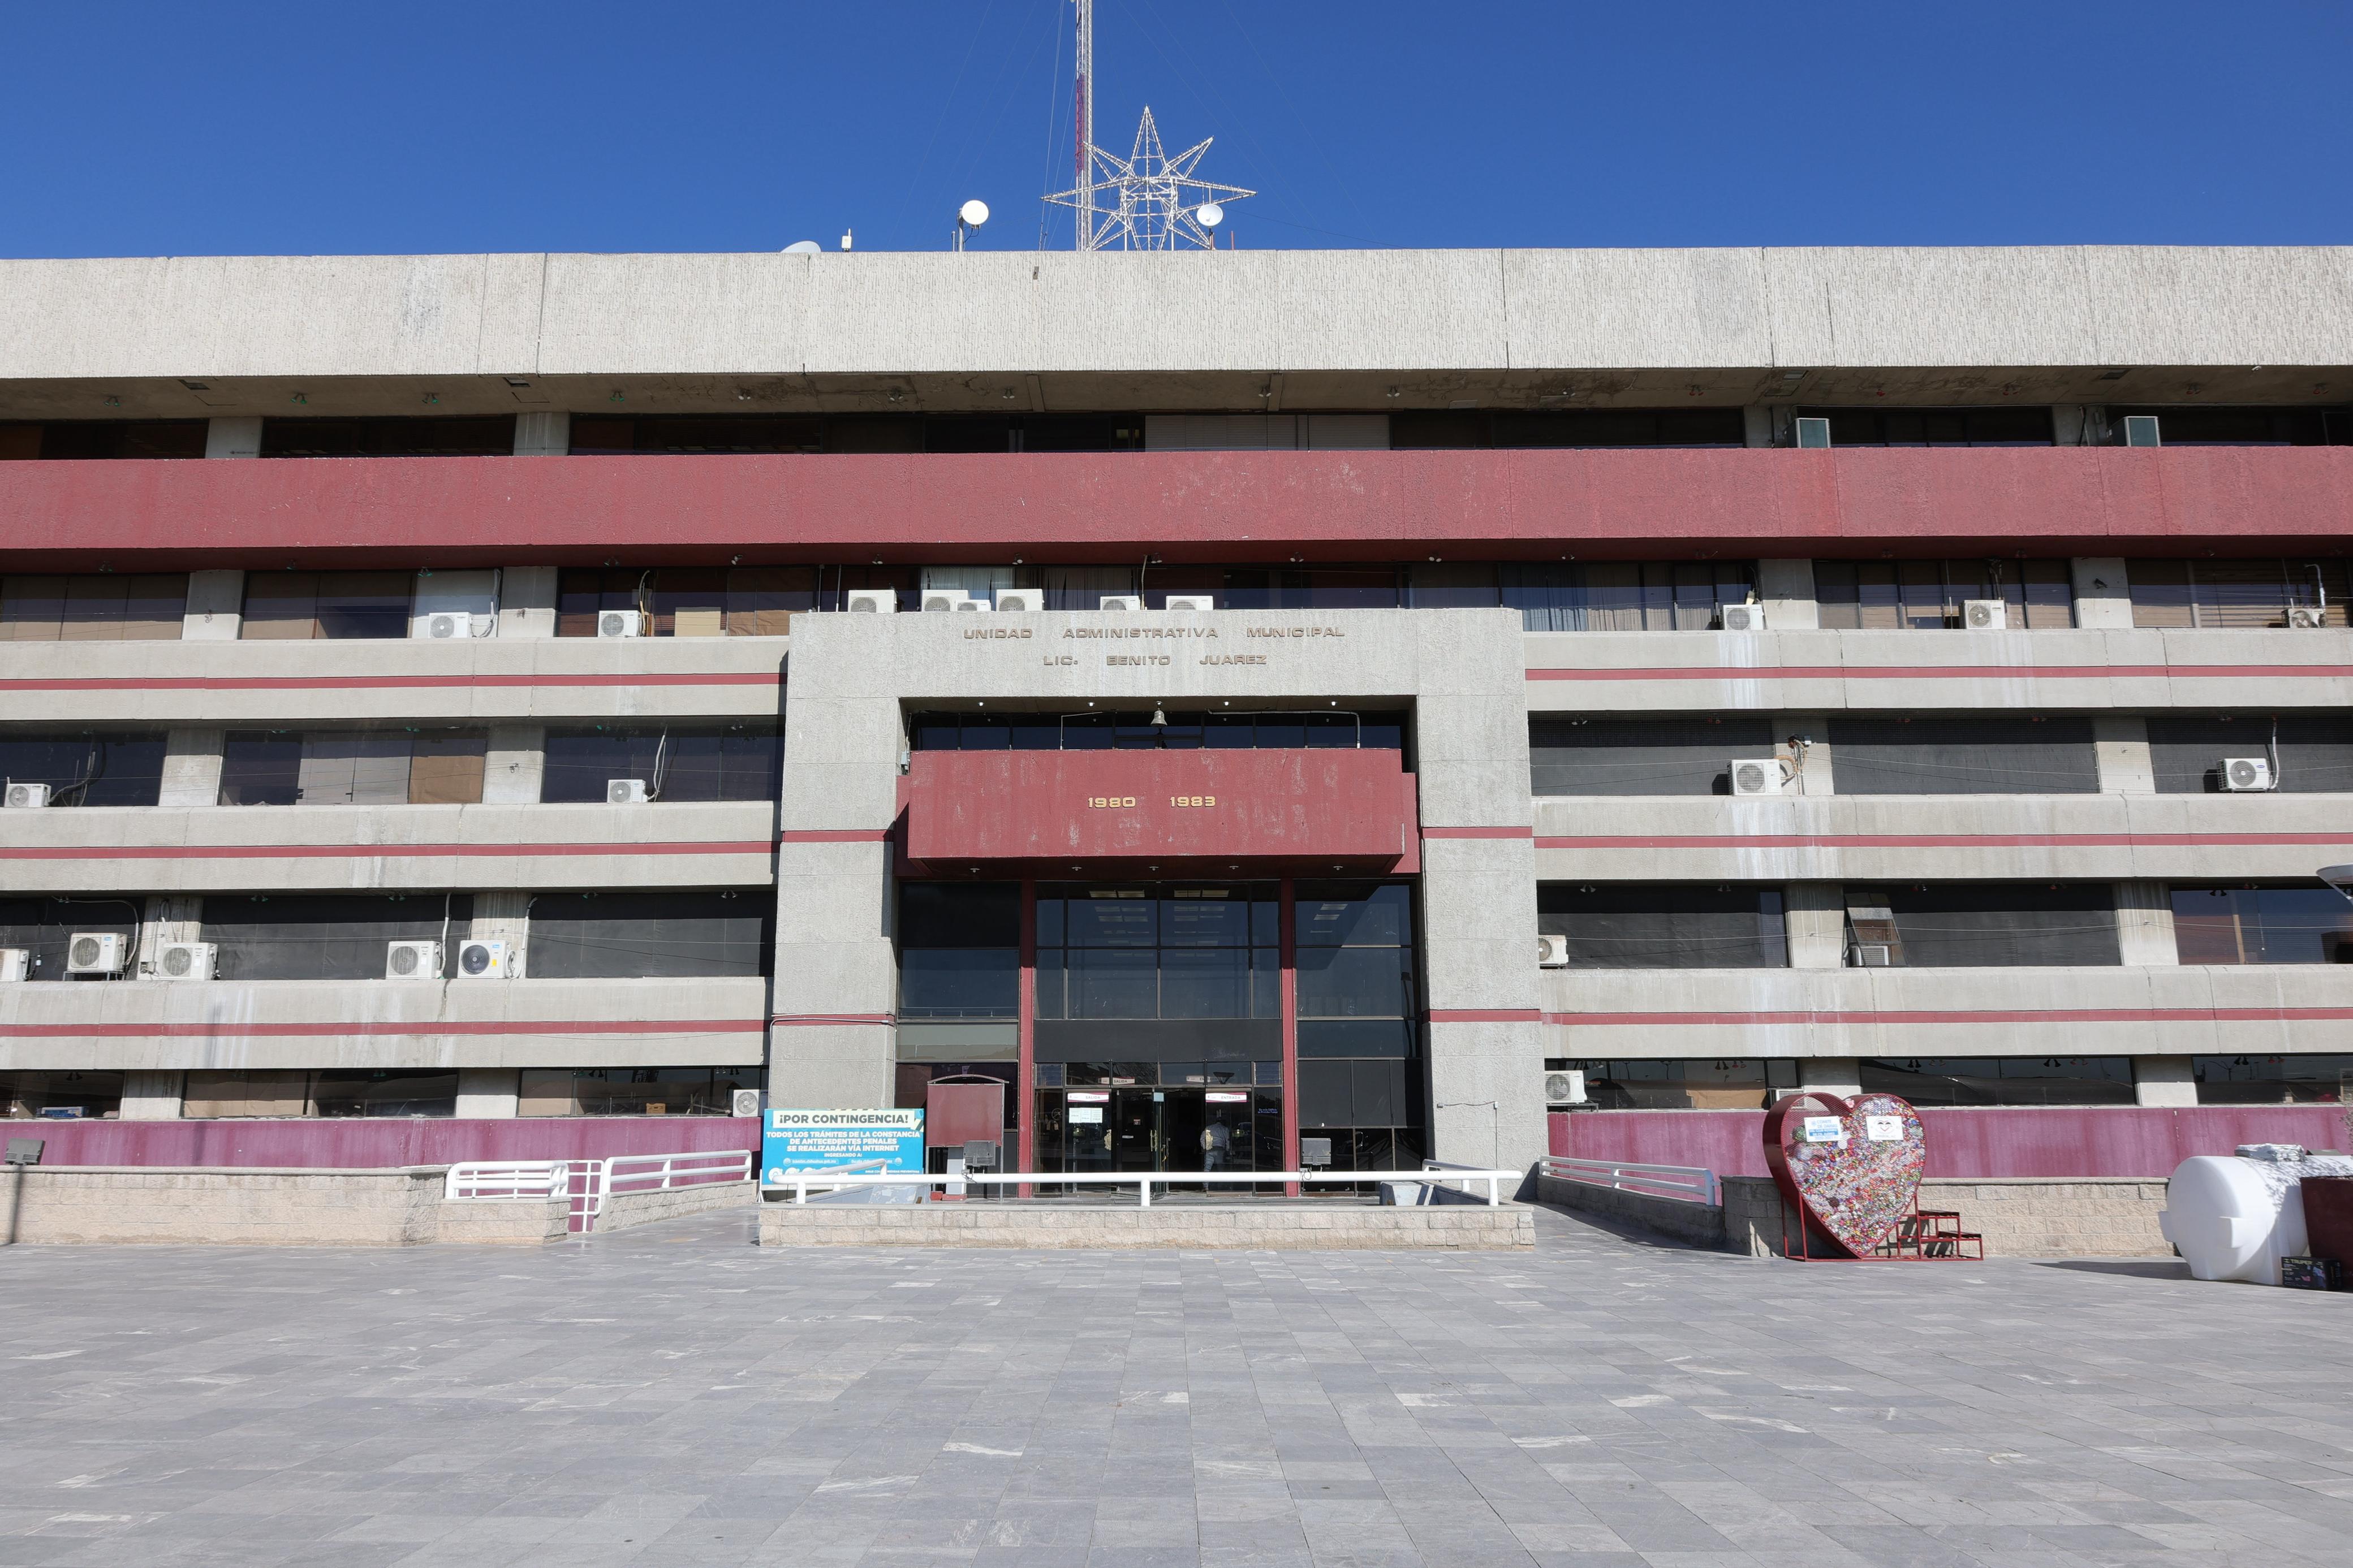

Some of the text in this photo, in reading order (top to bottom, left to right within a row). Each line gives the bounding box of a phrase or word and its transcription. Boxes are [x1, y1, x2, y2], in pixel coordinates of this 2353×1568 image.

[964, 627, 1345, 639] UNIDAD ADMINISTRATIVA MUNICIPAL
[1044, 655, 1267, 666] LIC. BENITO JUAREZ
[1088, 796, 1216, 809] 1980 1983
[779, 1115, 908, 1124] ¡POR CONTINGENCIA!
[798, 1143, 847, 1152] REALIZARÁN
